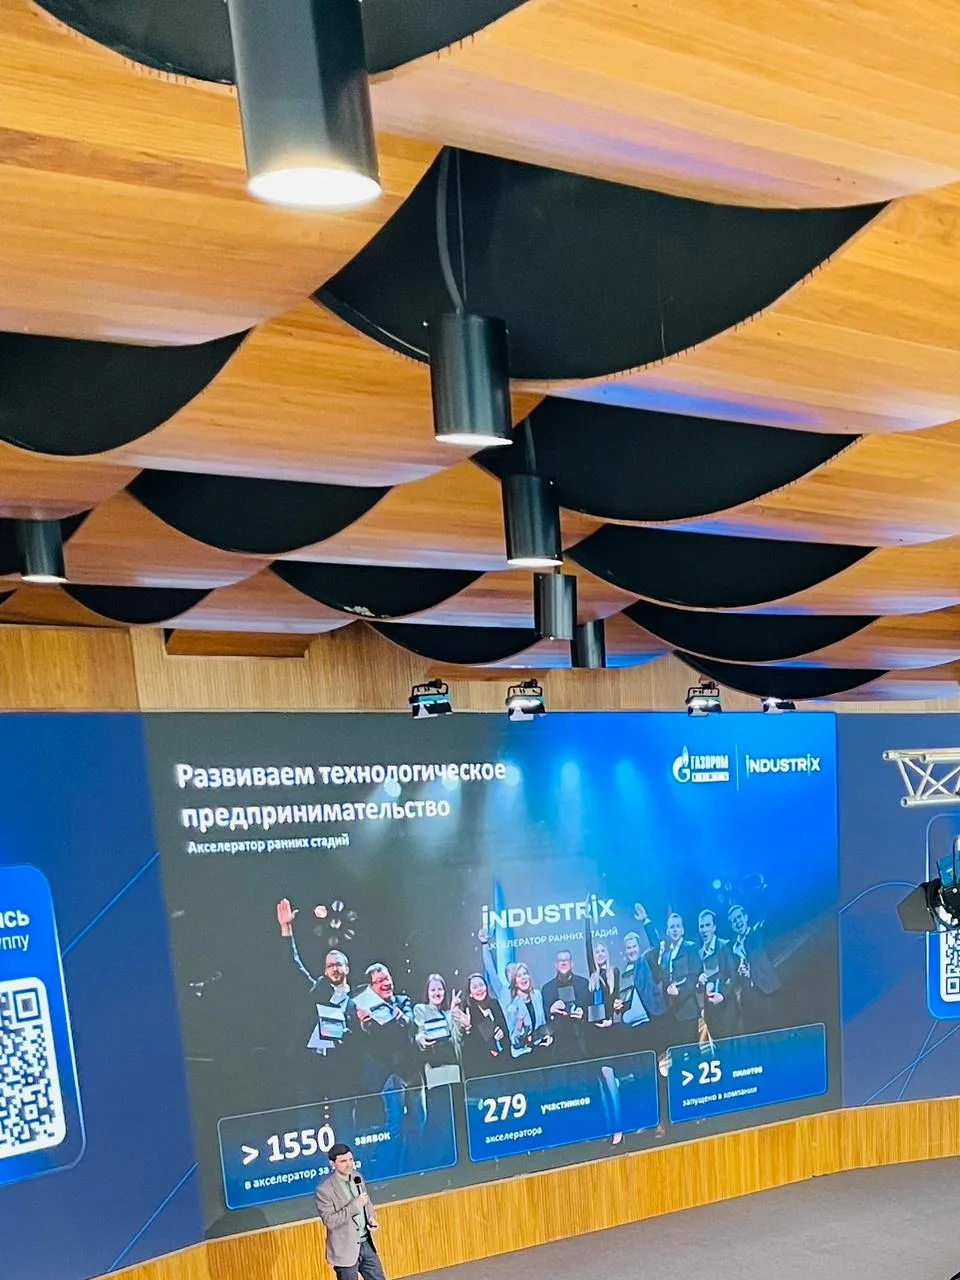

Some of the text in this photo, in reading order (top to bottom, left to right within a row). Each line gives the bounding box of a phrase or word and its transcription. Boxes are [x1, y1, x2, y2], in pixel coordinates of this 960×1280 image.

[690, 755, 729, 769] ГАЗПРОМ
[175, 762, 507, 788] Развиваем технологическое
[181, 800, 450, 833] предпринимательство
[187, 832, 350, 855] Акселератор ранних стадий
[548, 931, 585, 943] РАННИХ
[590, 926, 618, 938] ТАДИЙ
[698, 1060, 722, 1085] 25
[732, 1066, 764, 1078] пилотов
[484, 1093, 591, 1123] 279 участников
[682, 1093, 717, 1107] запущено
[723, 1087, 758, 1099] компании
[267, 1125, 336, 1162] 1550
[354, 1131, 391, 1146] заявок
[485, 1127, 543, 1144] акселератора
[244, 1167, 330, 1190] в акселератор за
